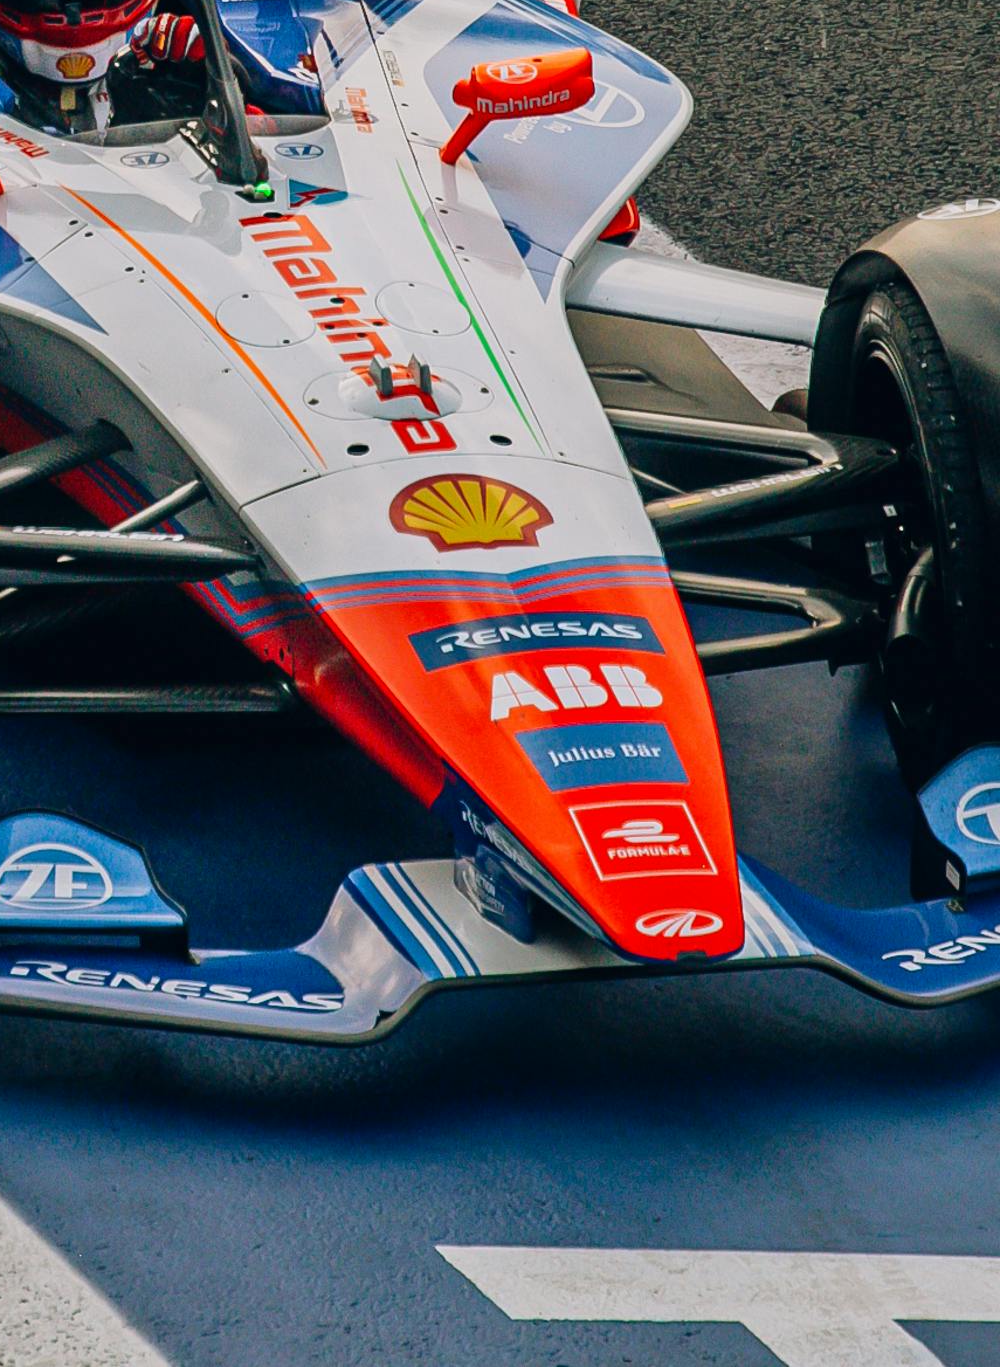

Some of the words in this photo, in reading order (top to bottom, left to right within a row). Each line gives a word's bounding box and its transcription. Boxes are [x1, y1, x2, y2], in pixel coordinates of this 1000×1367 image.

[476, 86, 571, 116] Mahindra
[239, 214, 457, 455] Mahindra
[435, 620, 643, 652] RENESAS
[490, 664, 664, 722] ABB
[548, 745, 616, 768] Julius
[622, 741, 662, 761] Bär
[10, 960, 344, 1011] RENESAS
